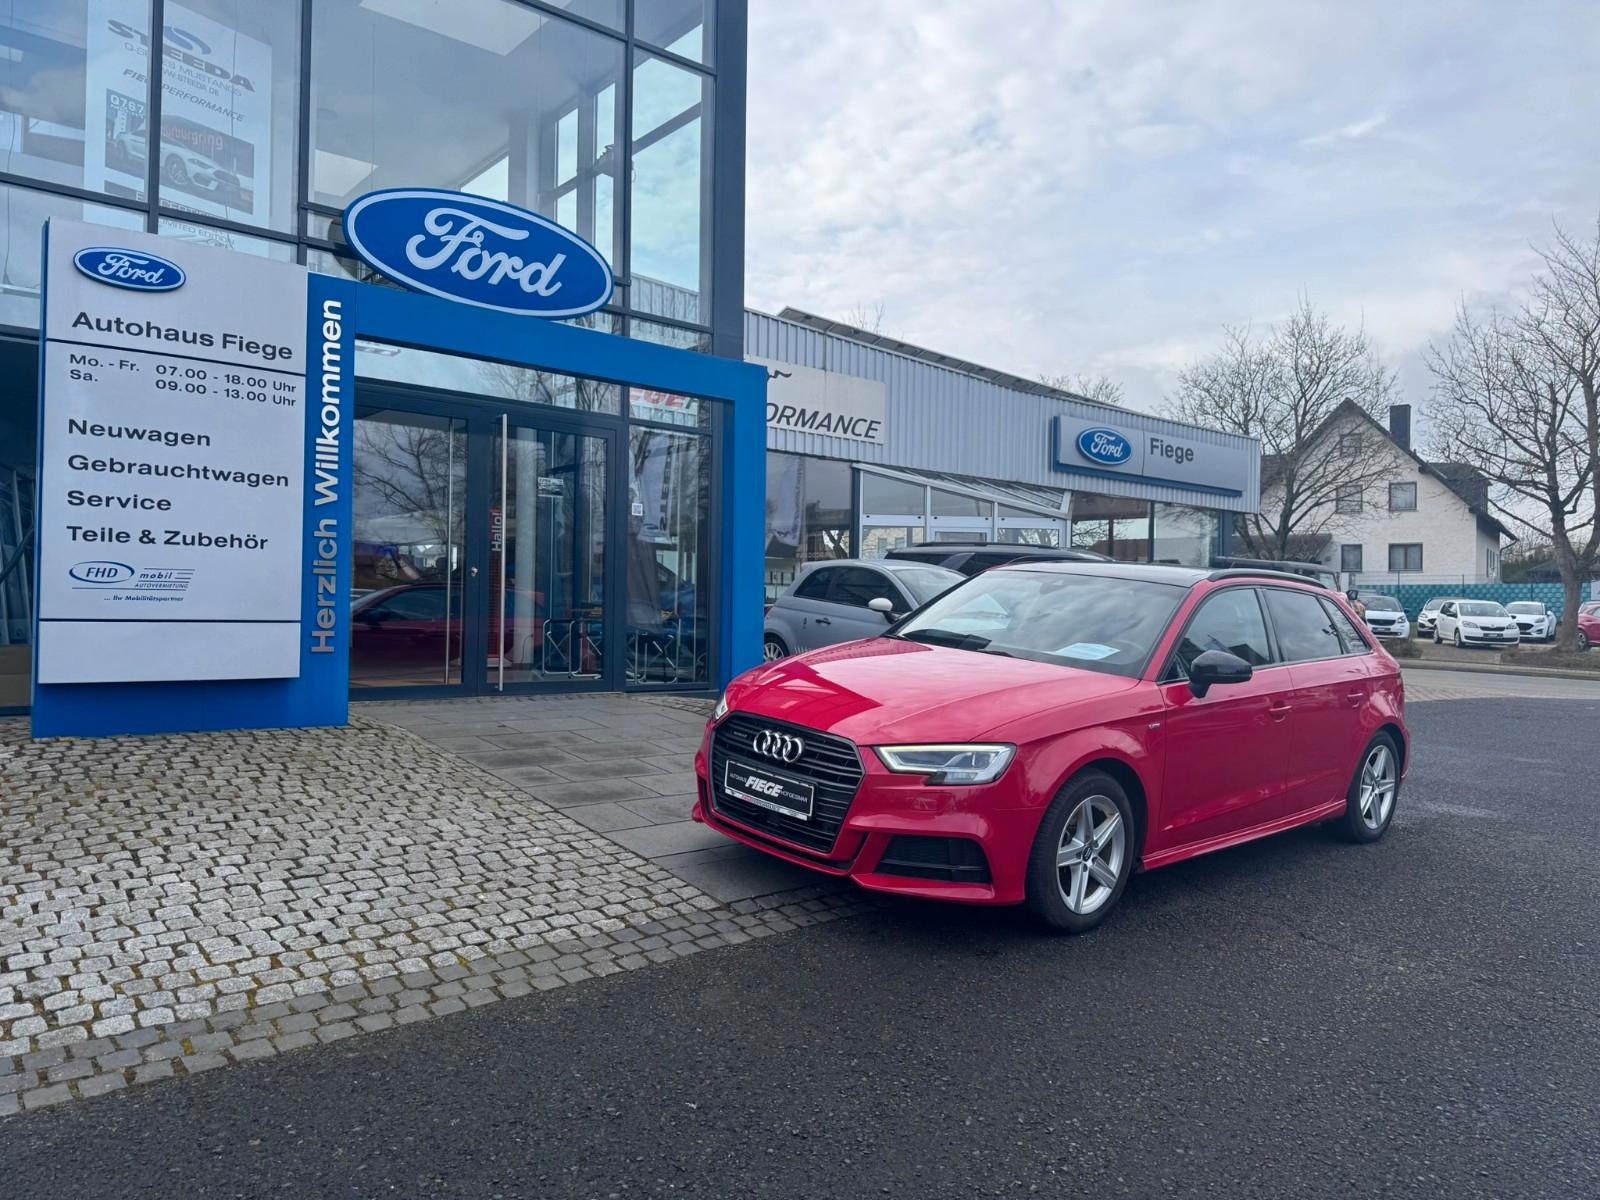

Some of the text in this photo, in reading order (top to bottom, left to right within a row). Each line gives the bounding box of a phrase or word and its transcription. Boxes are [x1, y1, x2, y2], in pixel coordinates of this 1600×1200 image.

[405, 207, 567, 297] Ford
[97, 253, 165, 285] Ford
[72, 311, 293, 361] Autohaus Fiege
[69, 353, 104, 368] Mo.
[119, 359, 140, 372] Fr.
[155, 364, 207, 380] 07.00
[224, 373, 267, 389] 18.00
[272, 380, 296, 393] Uhr
[69, 369, 98, 382] Sa.
[155, 378, 207, 395] 09.00
[224, 388, 267, 403] 13.00
[272, 394, 296, 407] Uhr
[314, 299, 342, 506] Willkommen
[68, 418, 211, 447] Neuwagen
[767, 402, 881, 440] ORMANCE
[1090, 432, 1124, 458] Ford
[1150, 437, 1194, 464] Fiege
[67, 454, 289, 488] Gebrauchtwagen
[67, 490, 172, 511] Service
[66, 525, 268, 550] Teile & Zubehör
[86, 567, 118, 579] FHD
[140, 571, 173, 580] mobil
[311, 518, 338, 653] Herzlich
[745, 776, 783, 797] FIEGE
